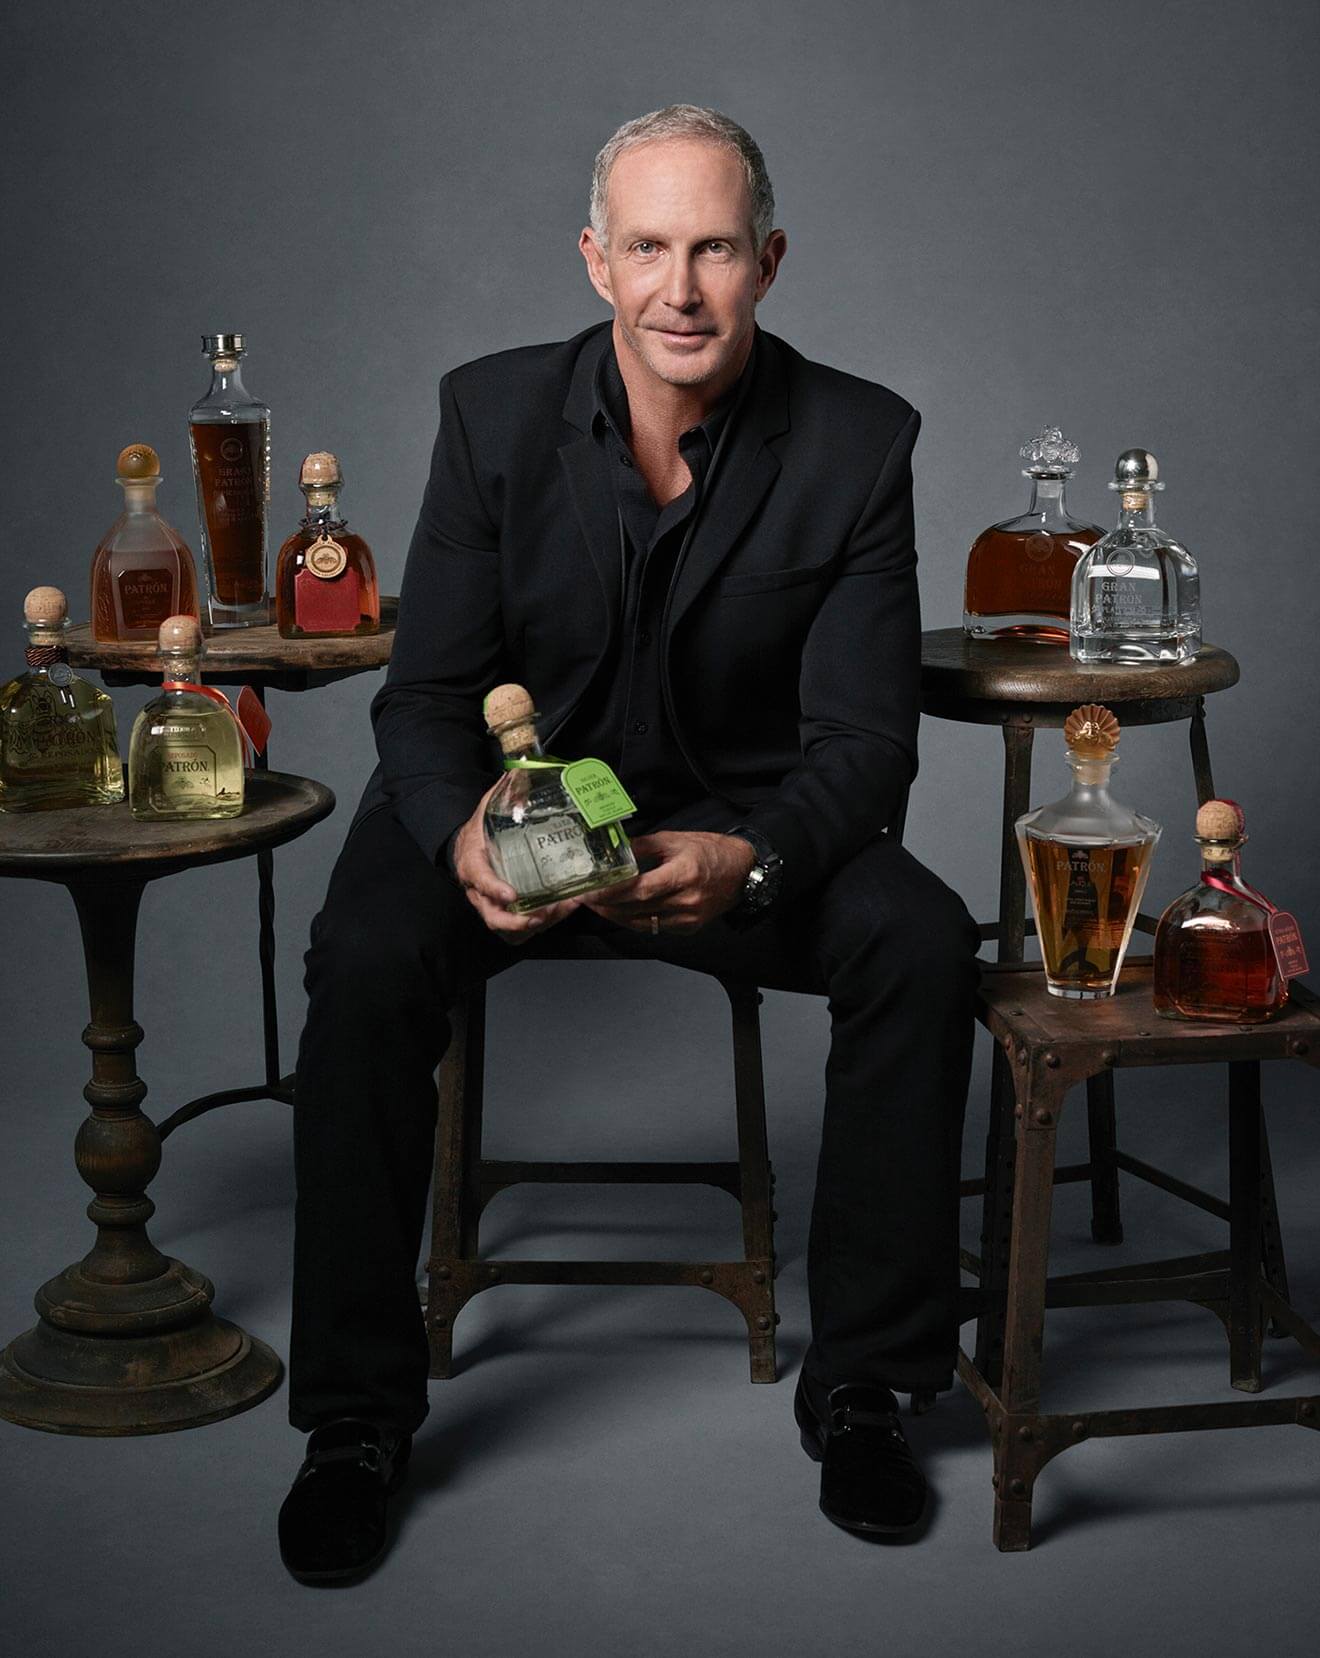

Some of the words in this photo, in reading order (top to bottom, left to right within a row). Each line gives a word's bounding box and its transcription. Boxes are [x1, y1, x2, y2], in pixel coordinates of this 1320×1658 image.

[1101, 582, 1137, 592] GRAN
[163, 758, 209, 773] ATRÓN
[1056, 860, 1106, 873] PATRÓN
